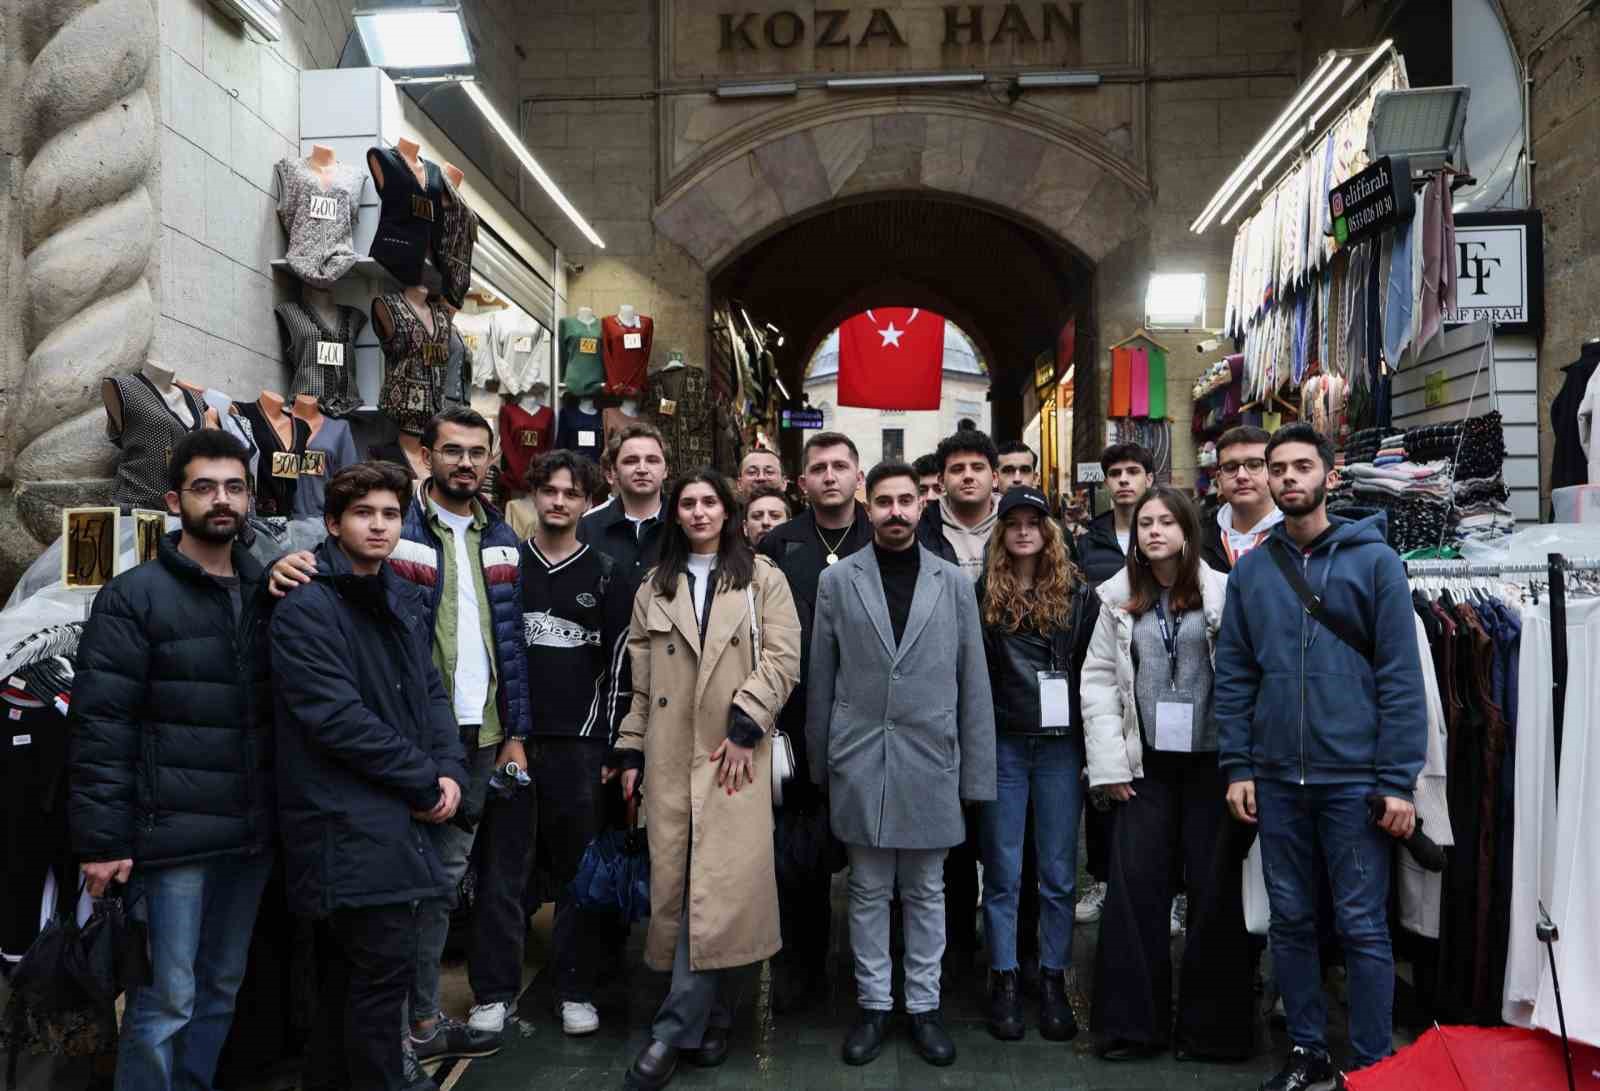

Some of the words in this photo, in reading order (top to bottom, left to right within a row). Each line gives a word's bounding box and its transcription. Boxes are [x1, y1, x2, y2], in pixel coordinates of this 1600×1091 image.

[718, 8, 909, 53] KOZA
[940, 2, 1083, 47] HAN
[1345, 167, 1388, 207] eliffarah
[311, 198, 336, 216] 400
[1473, 308, 1523, 321] FARAH
